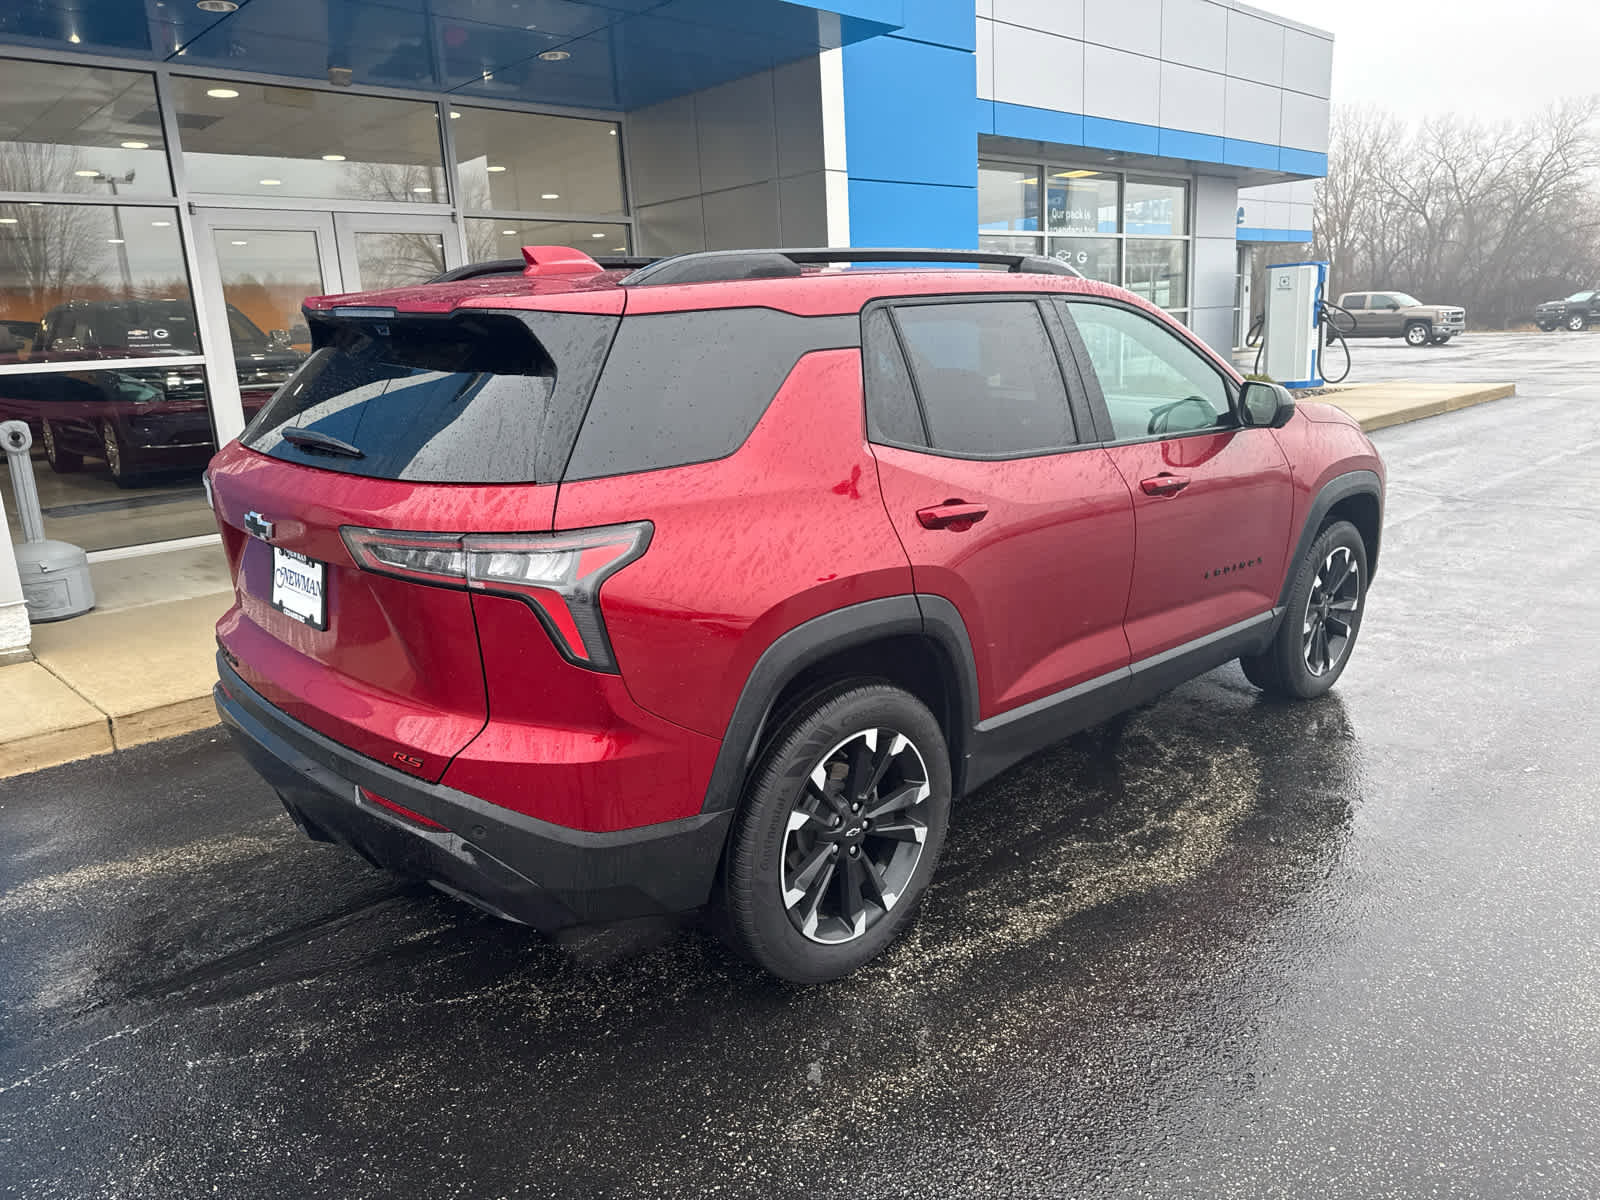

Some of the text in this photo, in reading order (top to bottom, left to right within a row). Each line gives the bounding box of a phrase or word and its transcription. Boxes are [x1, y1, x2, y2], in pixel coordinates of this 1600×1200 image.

[1051, 207, 1064, 219] Our
[275, 566, 321, 598] NEWMAN
[392, 751, 424, 767] RS
